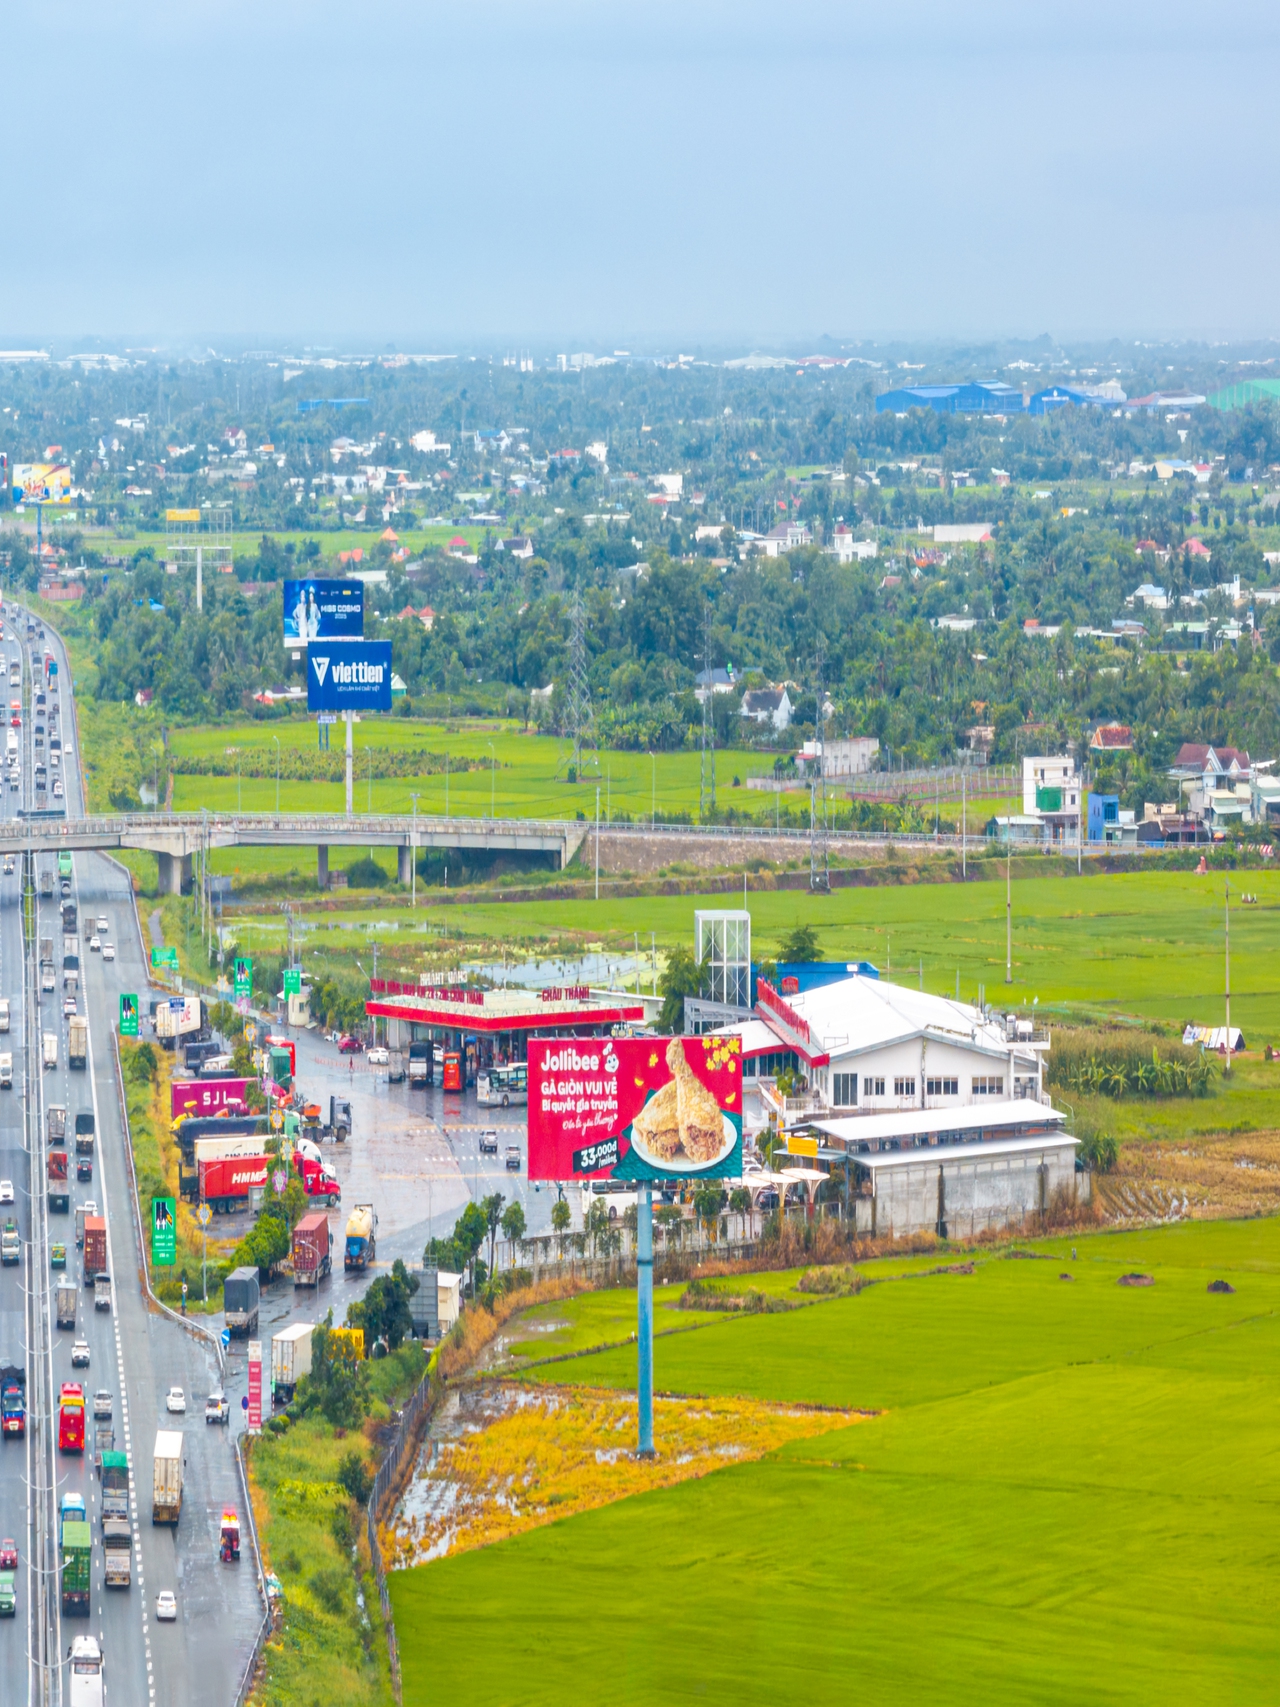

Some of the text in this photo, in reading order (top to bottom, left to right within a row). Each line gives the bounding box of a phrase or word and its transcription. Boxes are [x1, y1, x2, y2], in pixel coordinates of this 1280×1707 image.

[332, 661, 383, 683] viettien
[541, 1048, 599, 1071] Jollibee
[541, 1076, 618, 1095] GÀ GIÒN VUI VẺ
[232, 1171, 262, 1184] HMM
